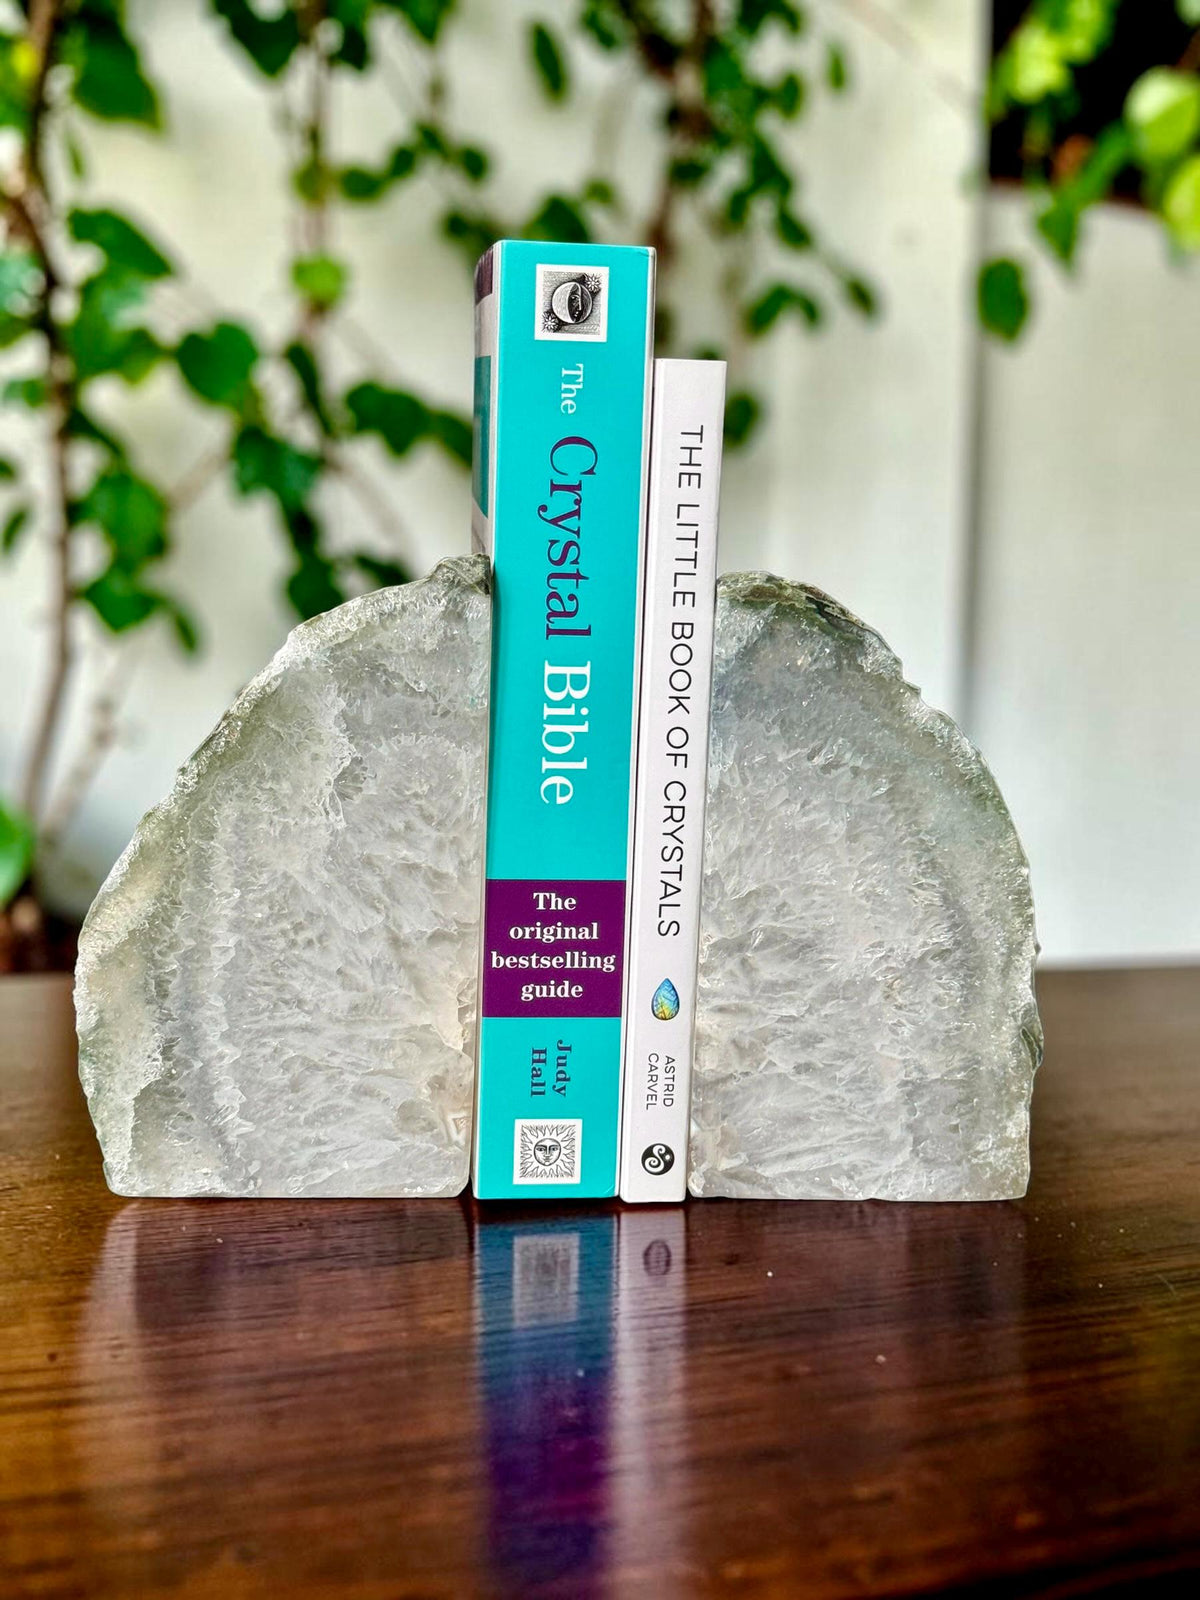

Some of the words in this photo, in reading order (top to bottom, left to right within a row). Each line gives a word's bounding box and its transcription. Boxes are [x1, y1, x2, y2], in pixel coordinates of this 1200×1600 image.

[560, 363, 584, 414] The
[678, 425, 704, 489] THE
[537, 436, 598, 640] Crystal
[672, 504, 700, 608] LITTLE
[668, 622, 694, 715] BOOK
[540, 660, 592, 805] Bible
[665, 726, 689, 769] OF
[657, 780, 687, 937] CRYSTALS
[533, 892, 577, 911] The
[509, 922, 600, 944] original
[491, 951, 616, 972] bestselling
[521, 980, 584, 1002] guide
[530, 1047, 547, 1098] Hall
[553, 1039, 572, 1098] Judy
[646, 1053, 660, 1110] CARVEL
[663, 1055, 676, 1108] ASTRID
